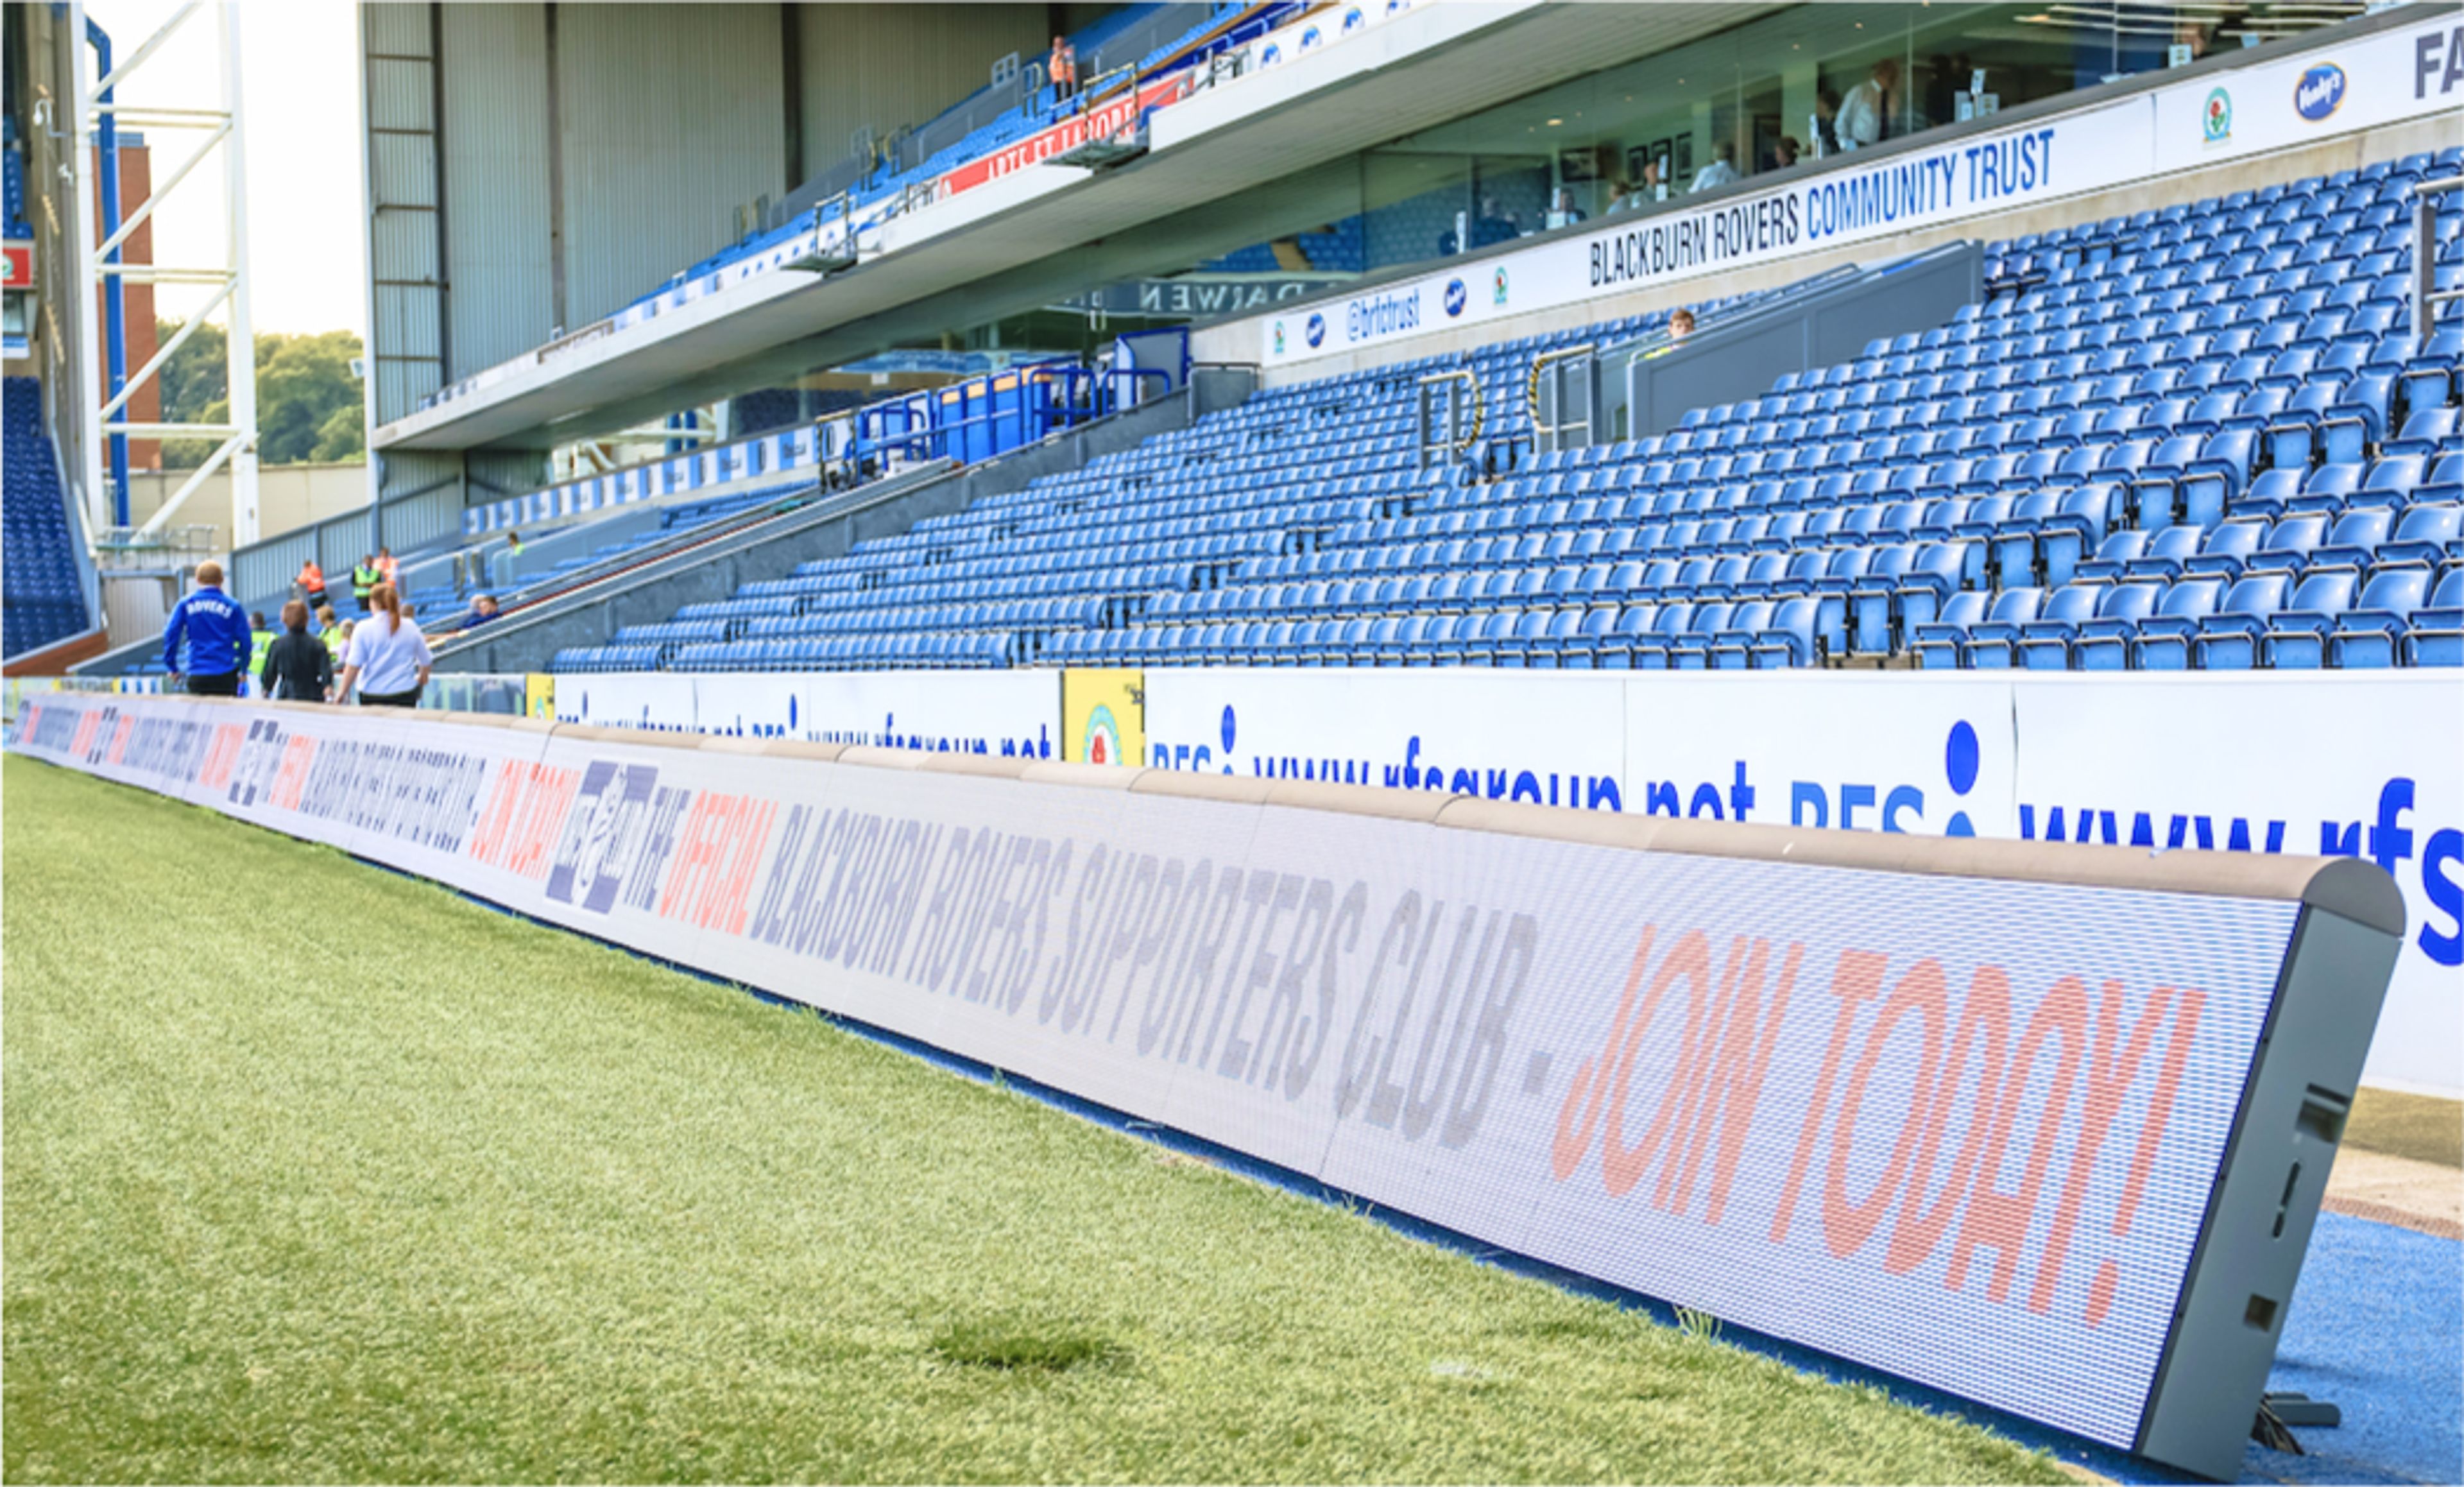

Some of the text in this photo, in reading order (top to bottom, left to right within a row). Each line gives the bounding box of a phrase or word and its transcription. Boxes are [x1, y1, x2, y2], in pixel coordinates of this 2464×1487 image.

[1590, 128, 2055, 288] BLACKBURN ROVERS COMMUNITY TRUST
[660, 788, 779, 938] OFFICIAL
[749, 804, 943, 977] BLACKBURN
[905, 824, 1074, 1016] ROVERS
[1038, 841, 1367, 1103] SUPPORTERS
[1334, 888, 1537, 1149] CLUB
[1550, 923, 1804, 1226] JOIN
[1768, 949, 2206, 1329] TODAY!
